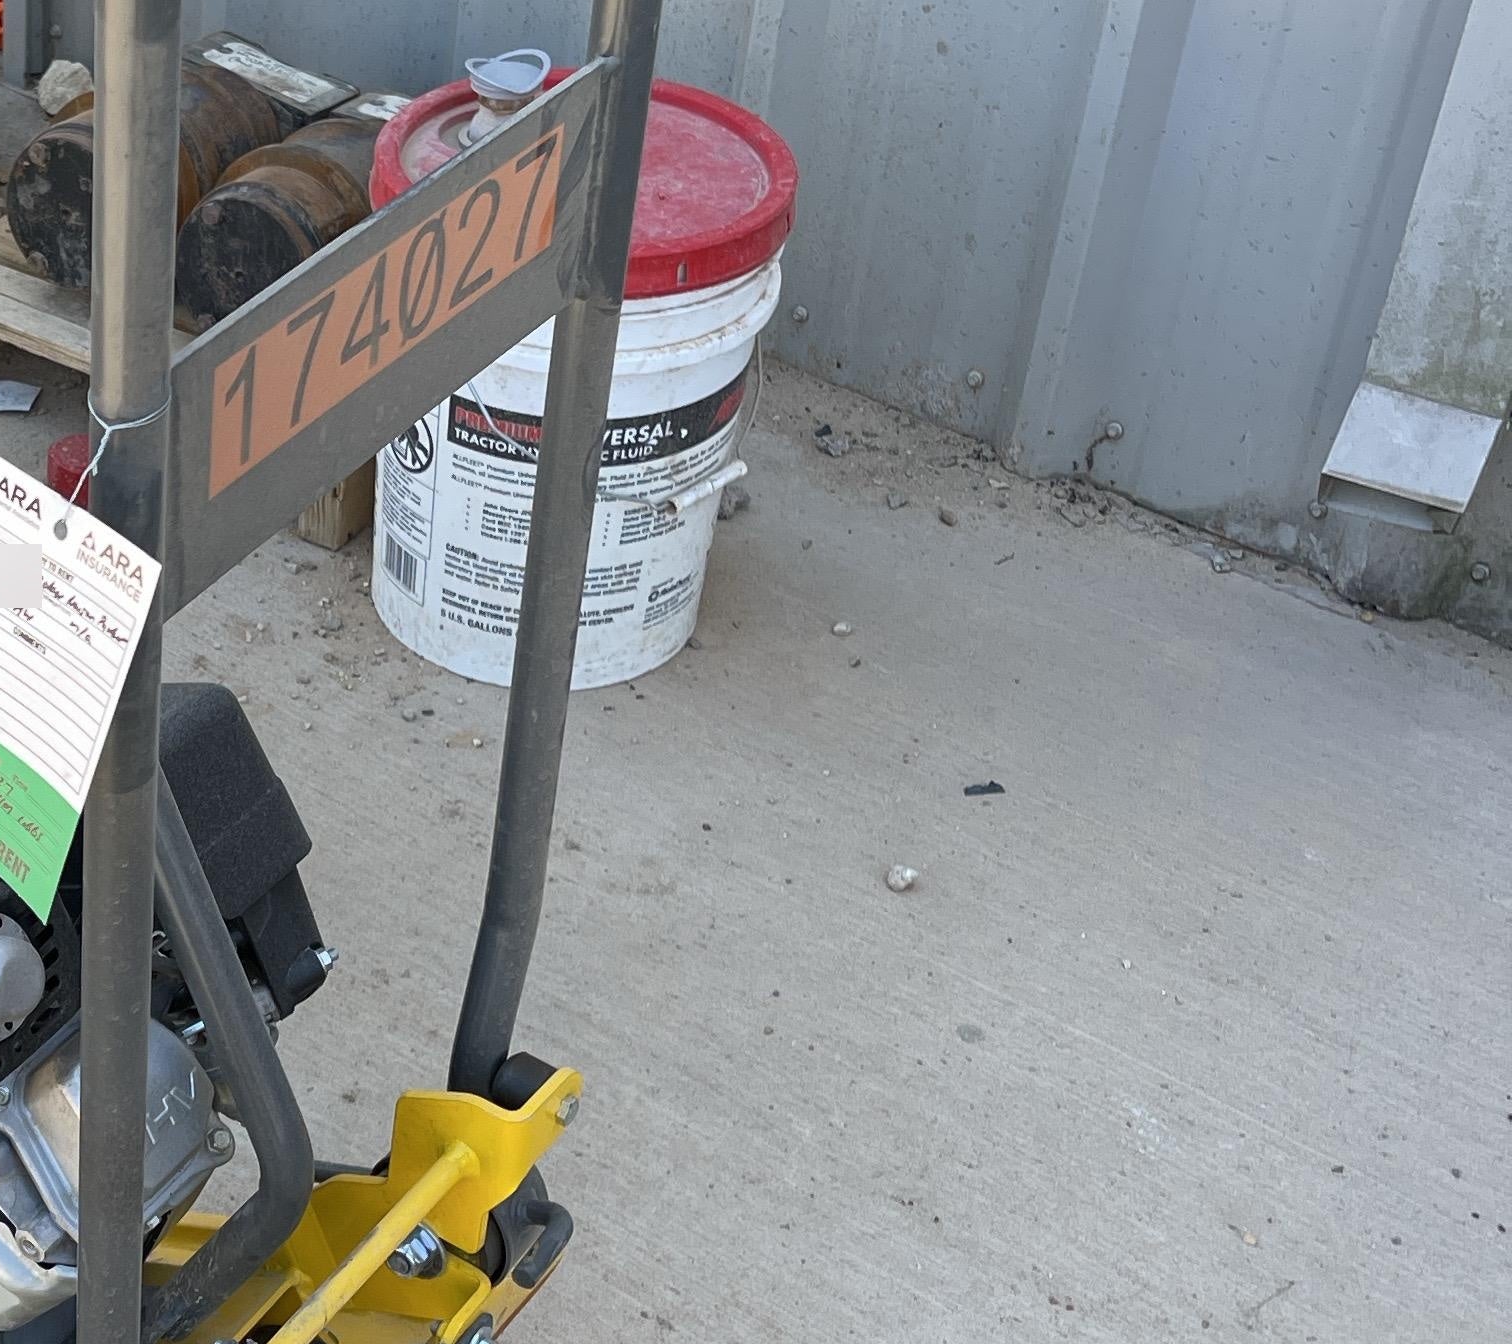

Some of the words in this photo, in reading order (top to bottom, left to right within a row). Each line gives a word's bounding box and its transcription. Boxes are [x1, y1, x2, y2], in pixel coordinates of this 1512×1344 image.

[224, 132, 558, 467] 174027
[453, 426, 517, 455] TRACTOR
[612, 445, 653, 462] FLUID
[75, 547, 142, 603] INSURANCE
[99, 543, 144, 588] ARA
